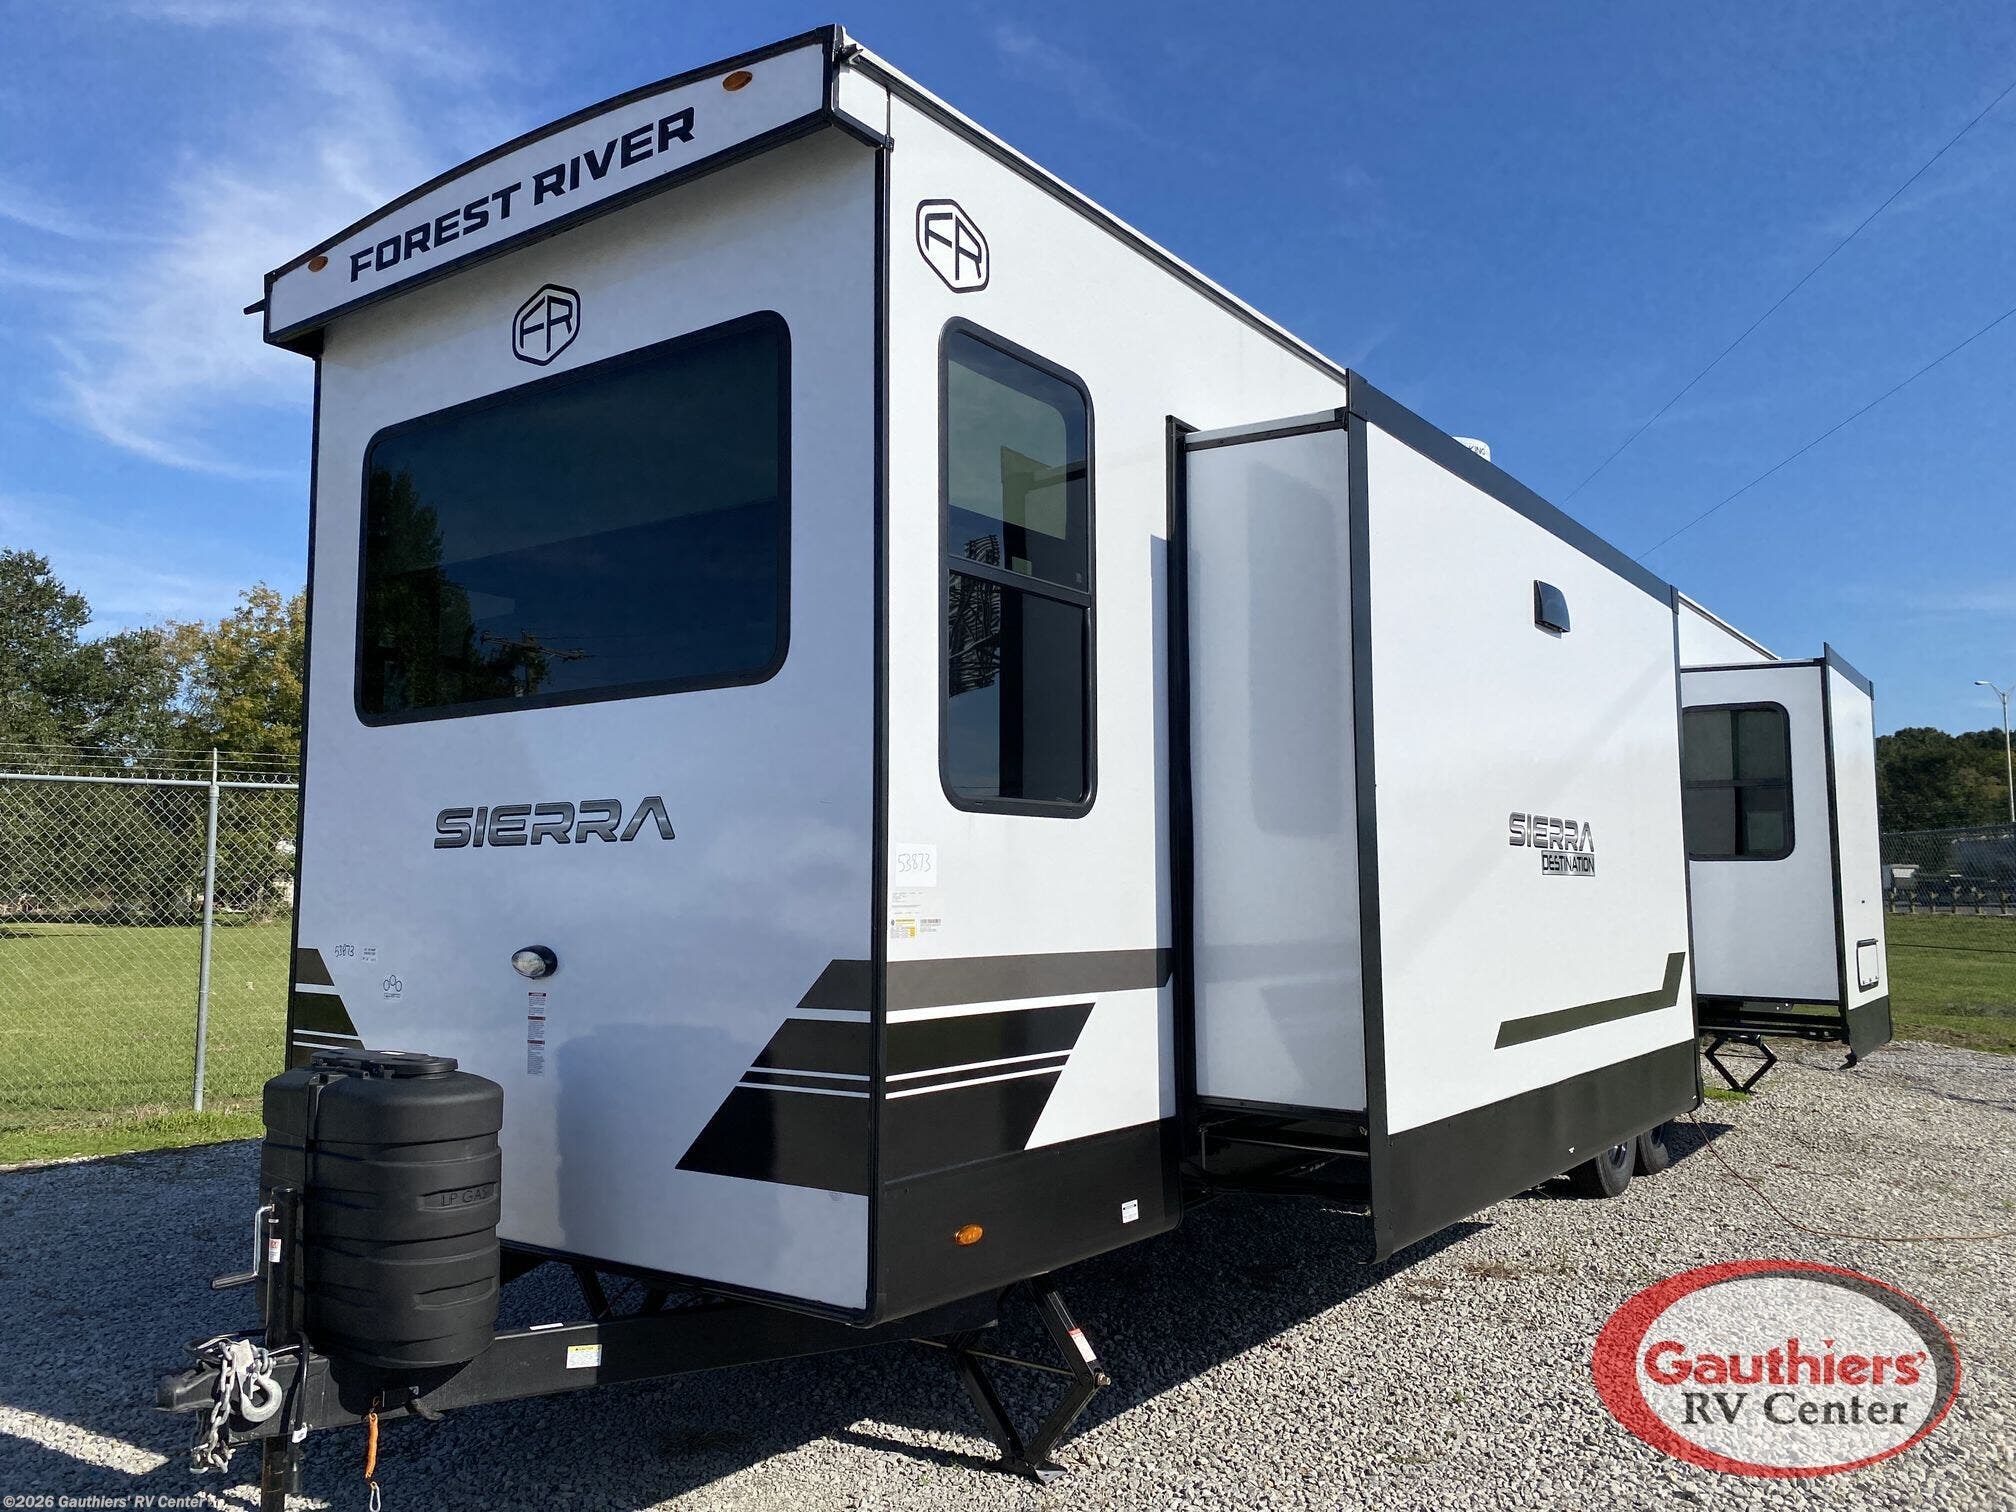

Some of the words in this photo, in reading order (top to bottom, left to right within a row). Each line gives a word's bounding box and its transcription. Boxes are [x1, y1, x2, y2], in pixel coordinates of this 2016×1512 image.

[350, 183, 521, 283] FOREST
[533, 107, 696, 205] RIVER
[434, 796, 675, 848] SIERRA
[1509, 812, 1594, 852] SIERRA
[897, 853, 931, 872] 53873
[1541, 853, 1595, 873] DESTINATION
[442, 1193, 458, 1206] LP
